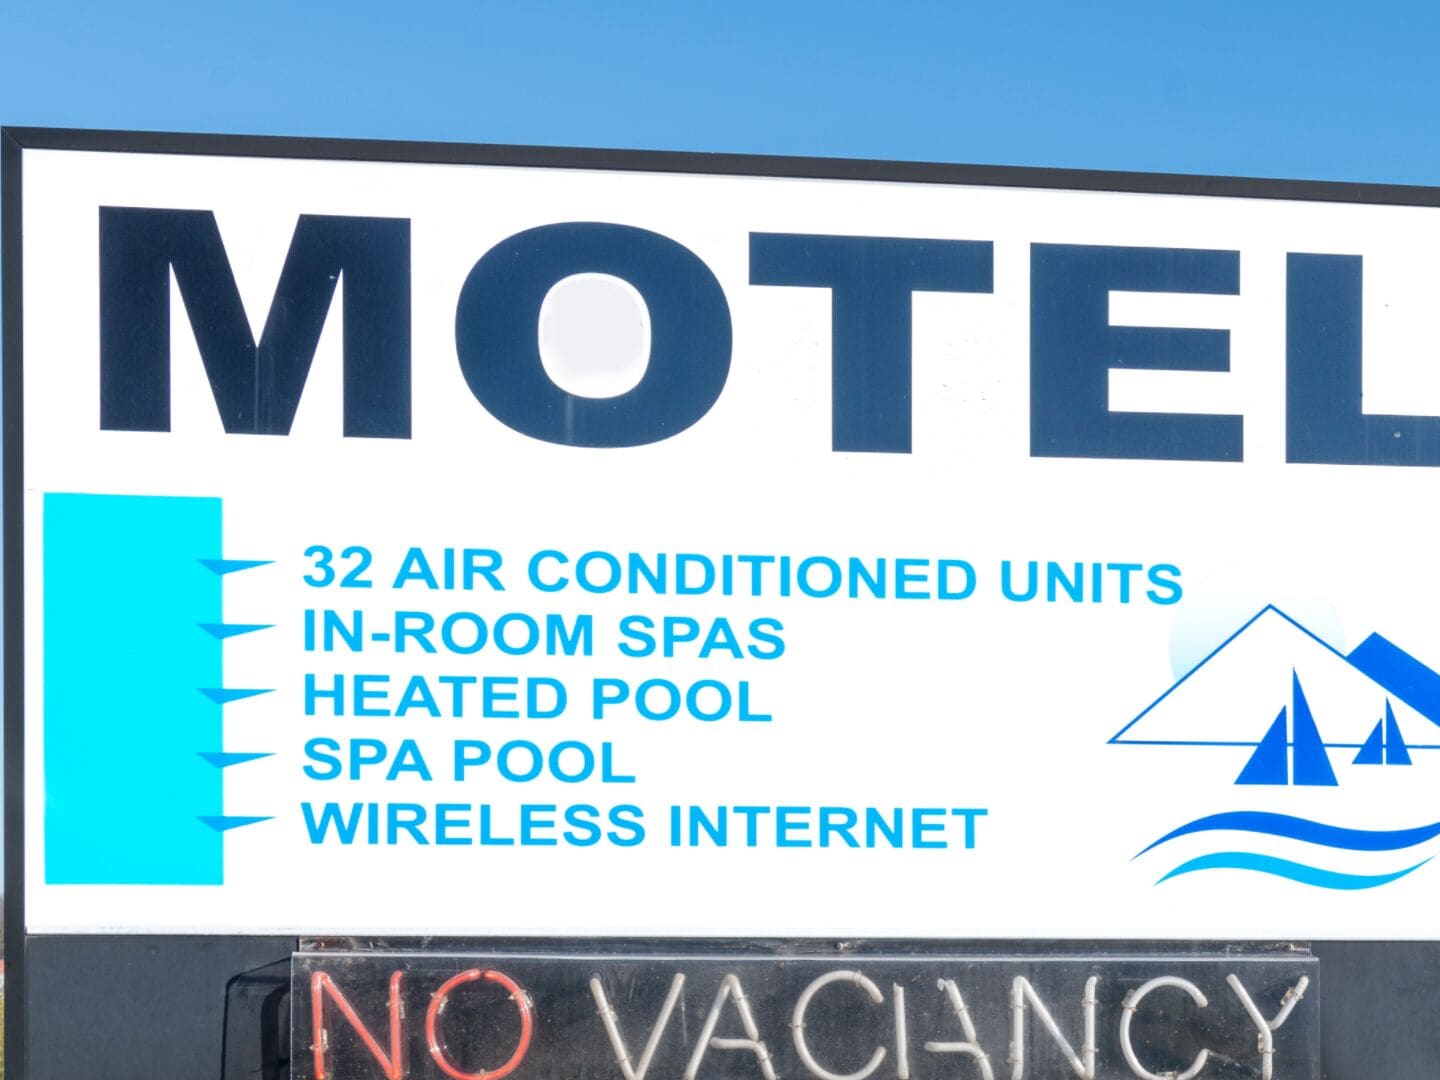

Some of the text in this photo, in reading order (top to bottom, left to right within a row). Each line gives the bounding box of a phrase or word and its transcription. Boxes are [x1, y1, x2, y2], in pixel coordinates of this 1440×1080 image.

[303, 544, 1183, 606] 32 AIR CONDITIONED UNITS
[303, 608, 786, 661] IN-ROOM SPAS
[303, 673, 773, 723] HEATED POOL
[302, 736, 636, 786] SPA POOL
[300, 801, 989, 850] WIRELESS INTERNET
